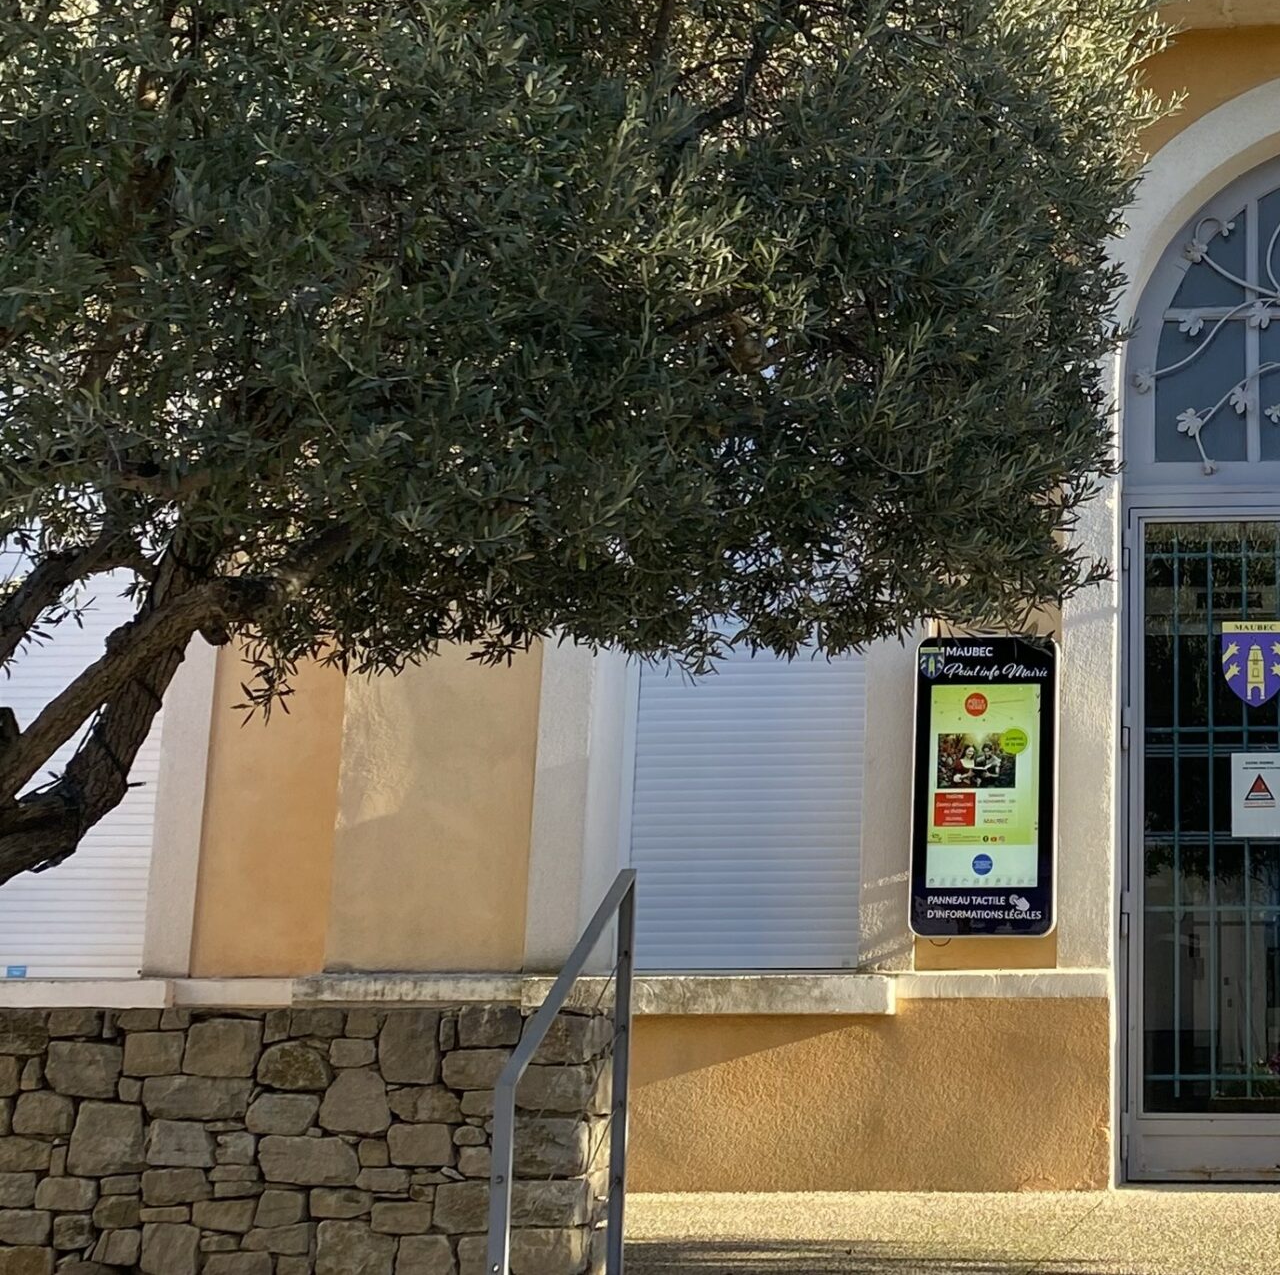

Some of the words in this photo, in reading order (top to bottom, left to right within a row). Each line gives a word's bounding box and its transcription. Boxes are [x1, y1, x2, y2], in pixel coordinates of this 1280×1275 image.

[1234, 623, 1277, 631] MAUBEC
[945, 646, 994, 657] MAUBEC
[943, 662, 979, 678] Point
[979, 665, 1000, 680] info
[1001, 662, 1048, 679] Mairie
[927, 895, 970, 905] PANNEAU
[971, 896, 1006, 905] TACTILE
[926, 909, 1004, 919] D'INFORMATIONS
[1004, 908, 1042, 920] LÉGALES
